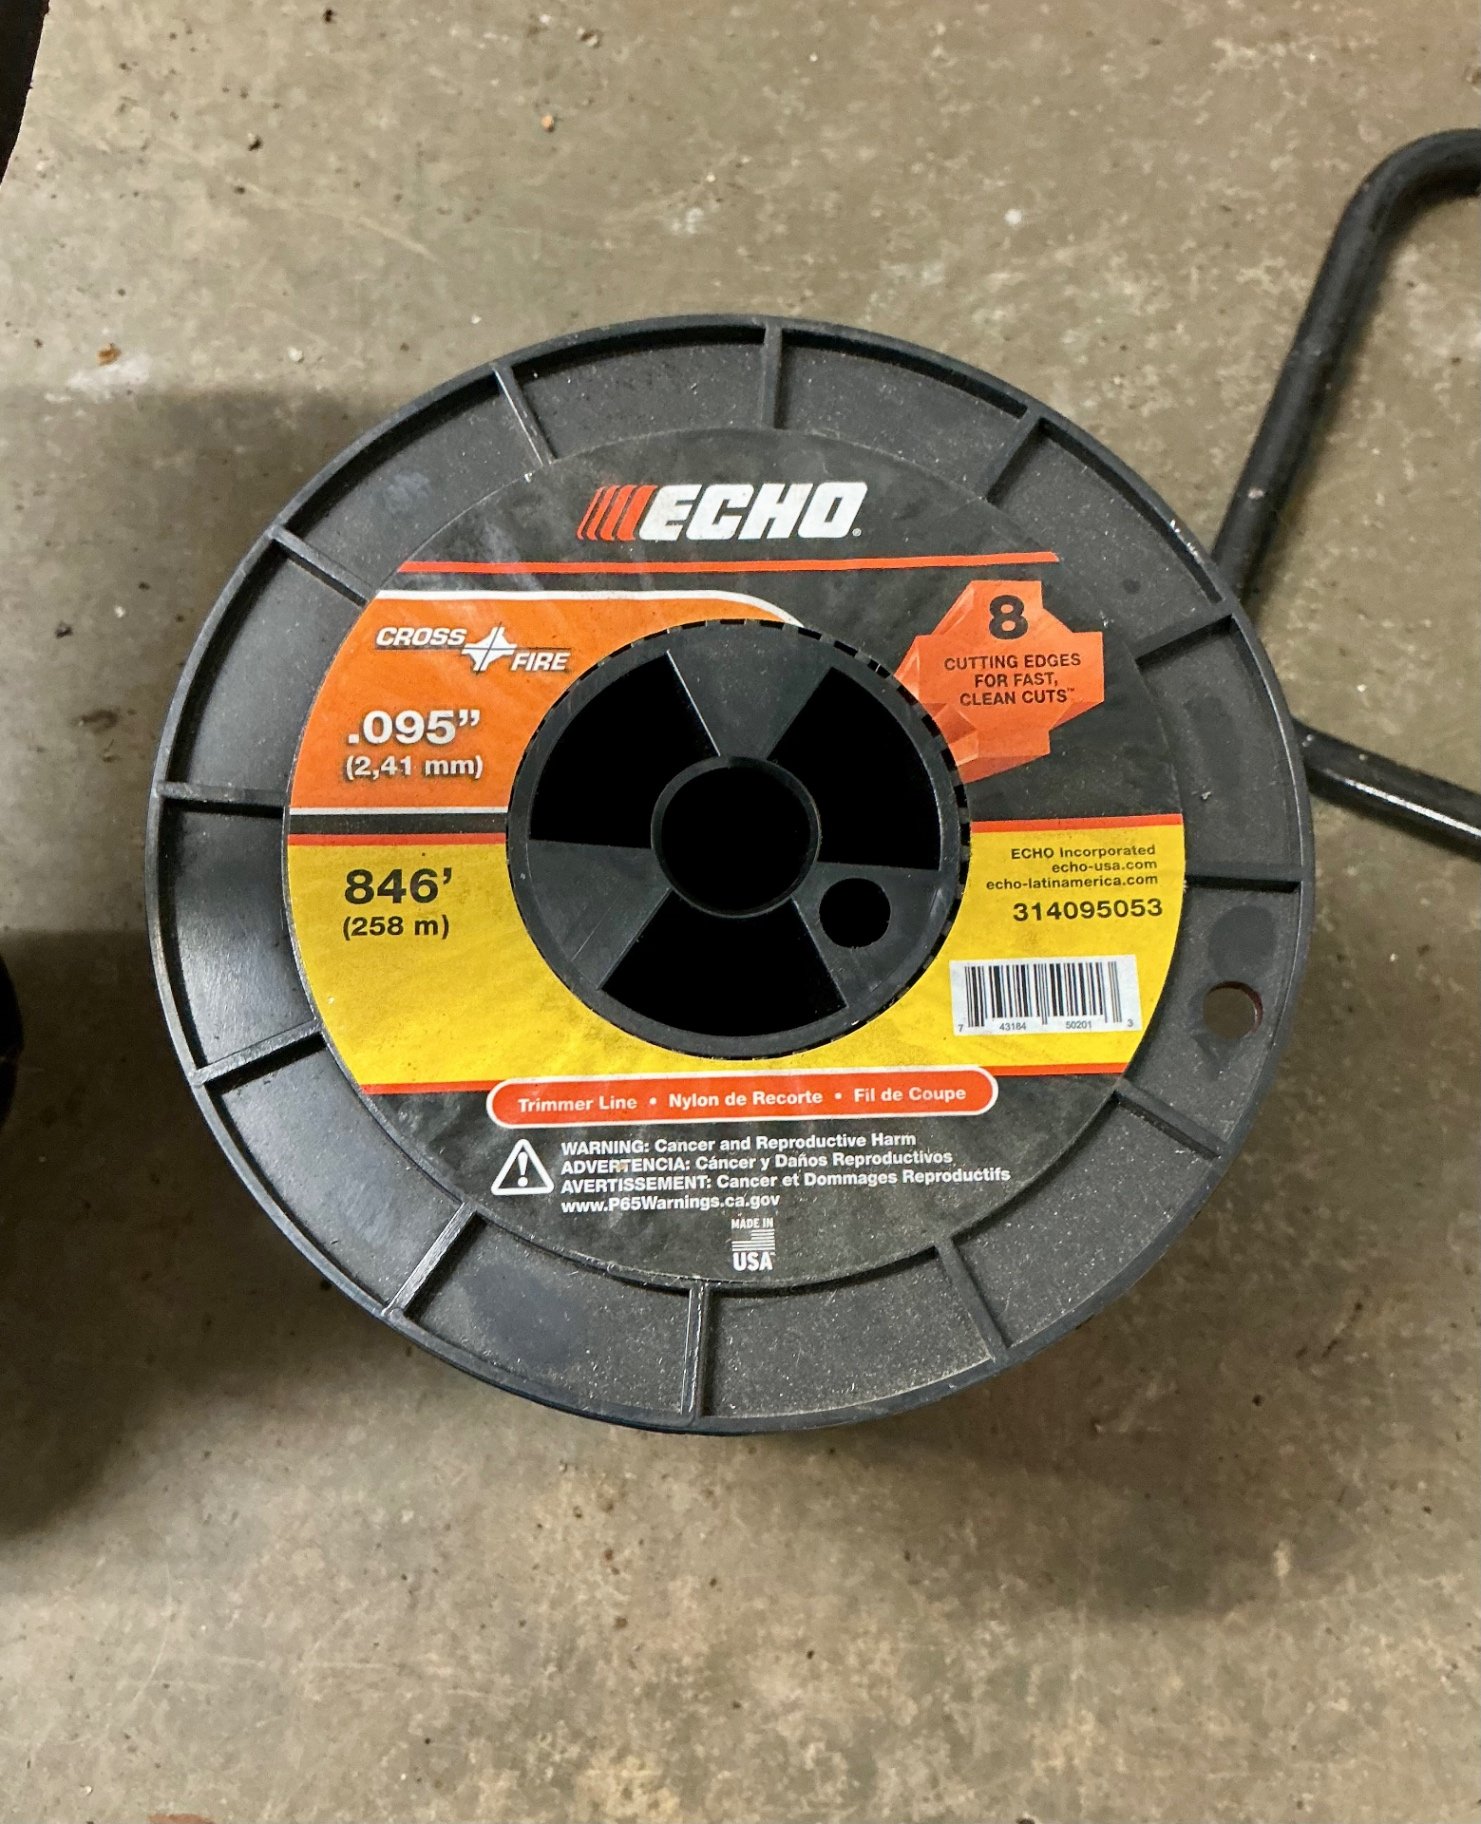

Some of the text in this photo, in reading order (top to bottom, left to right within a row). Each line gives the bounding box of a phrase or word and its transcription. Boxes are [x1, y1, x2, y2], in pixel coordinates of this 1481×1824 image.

[989, 595, 1029, 640] 8
[376, 627, 570, 672] CROSS FIRE
[944, 653, 1082, 671] CUTTING EDGES
[975, 672, 1058, 688] FOR FAST,
[960, 692, 1016, 706] CLEAN
[346, 755, 483, 780] (2,41 mm)
[1011, 844, 1156, 859] ECHO Incorporated
[1052, 860, 1157, 873] echo-usa.com
[986, 875, 1158, 890] echo-latinamerica.com
[1013, 898, 1163, 921] 314095053
[343, 916, 450, 940] (258 m)
[958, 1018, 1134, 1033] 7 43184 50201 3
[517, 1087, 967, 1113] Trimmer Line Nylon de Recorte Fil de Coupe
[561, 1132, 916, 1156] WARNING: Cancer and Reproductive Harm
[561, 1150, 953, 1175] ADVERTENCIA: Cáncer y Daños Reproductivos
[560, 1167, 1011, 1194] AVERTISSEMENT: Cancer et Dommages Reproductifs
[561, 1193, 780, 1213] www.P65Warnings.ca.gov
[731, 1217, 774, 1229] MADE IN
